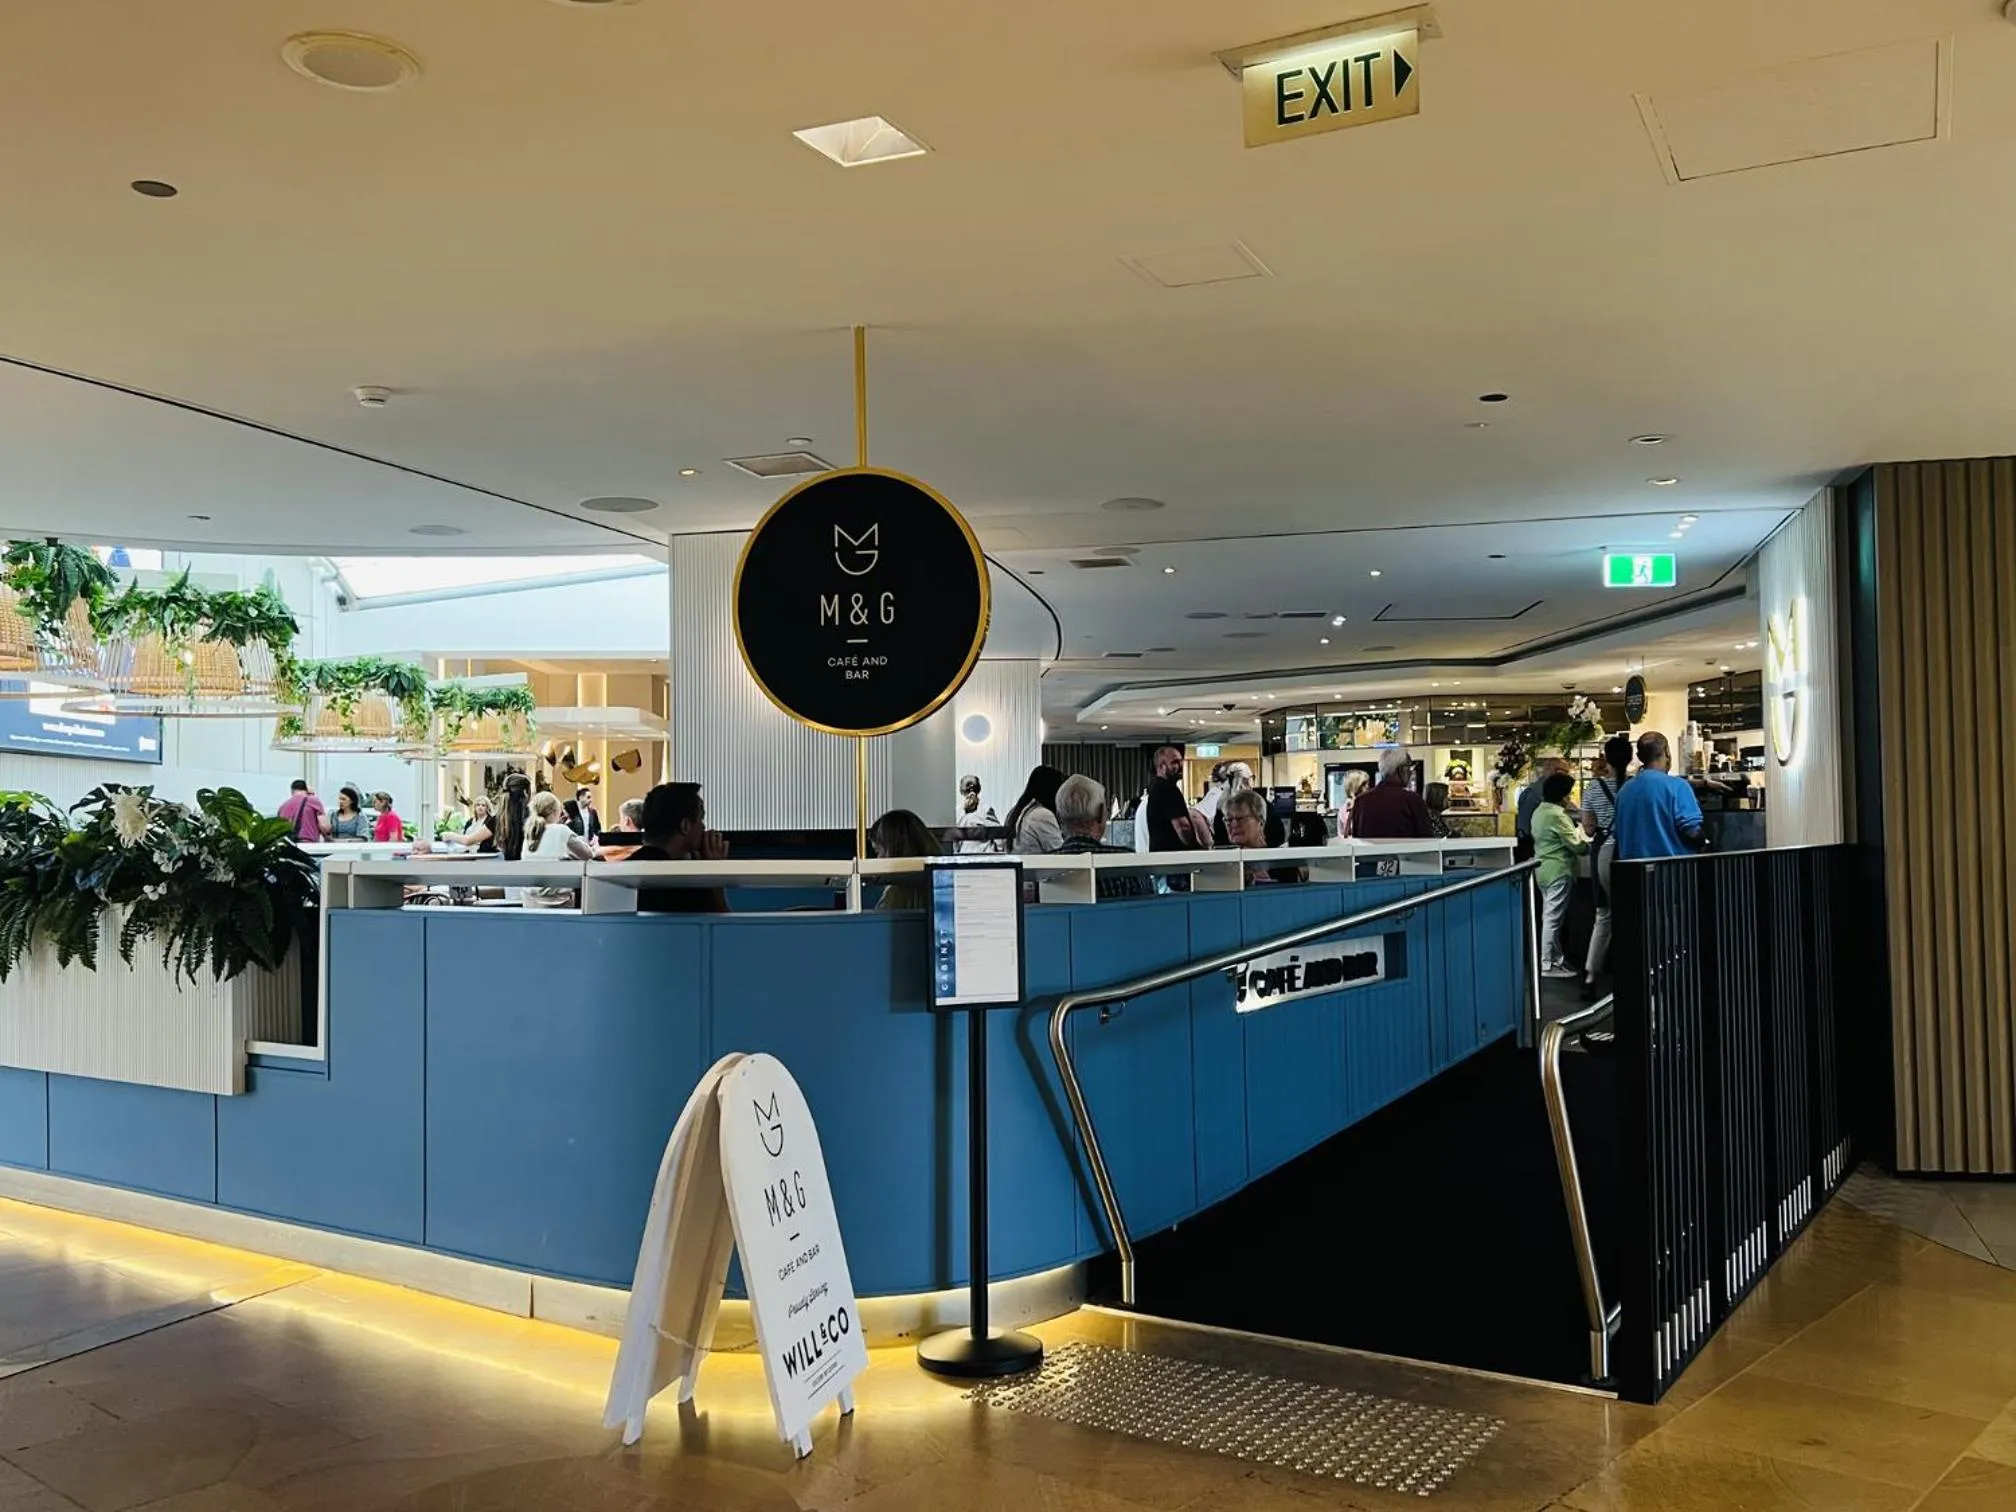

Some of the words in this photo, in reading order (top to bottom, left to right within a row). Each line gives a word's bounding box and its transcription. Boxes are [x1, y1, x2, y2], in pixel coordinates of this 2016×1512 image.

[1277, 51, 1381, 126] EXIT
[820, 593, 840, 626] M
[849, 592, 869, 625] &
[880, 591, 895, 624] G
[845, 670, 869, 680] BAR
[862, 655, 888, 666] AND
[764, 1184, 781, 1226] M
[780, 1178, 796, 1218] &
[794, 1170, 806, 1209] G
